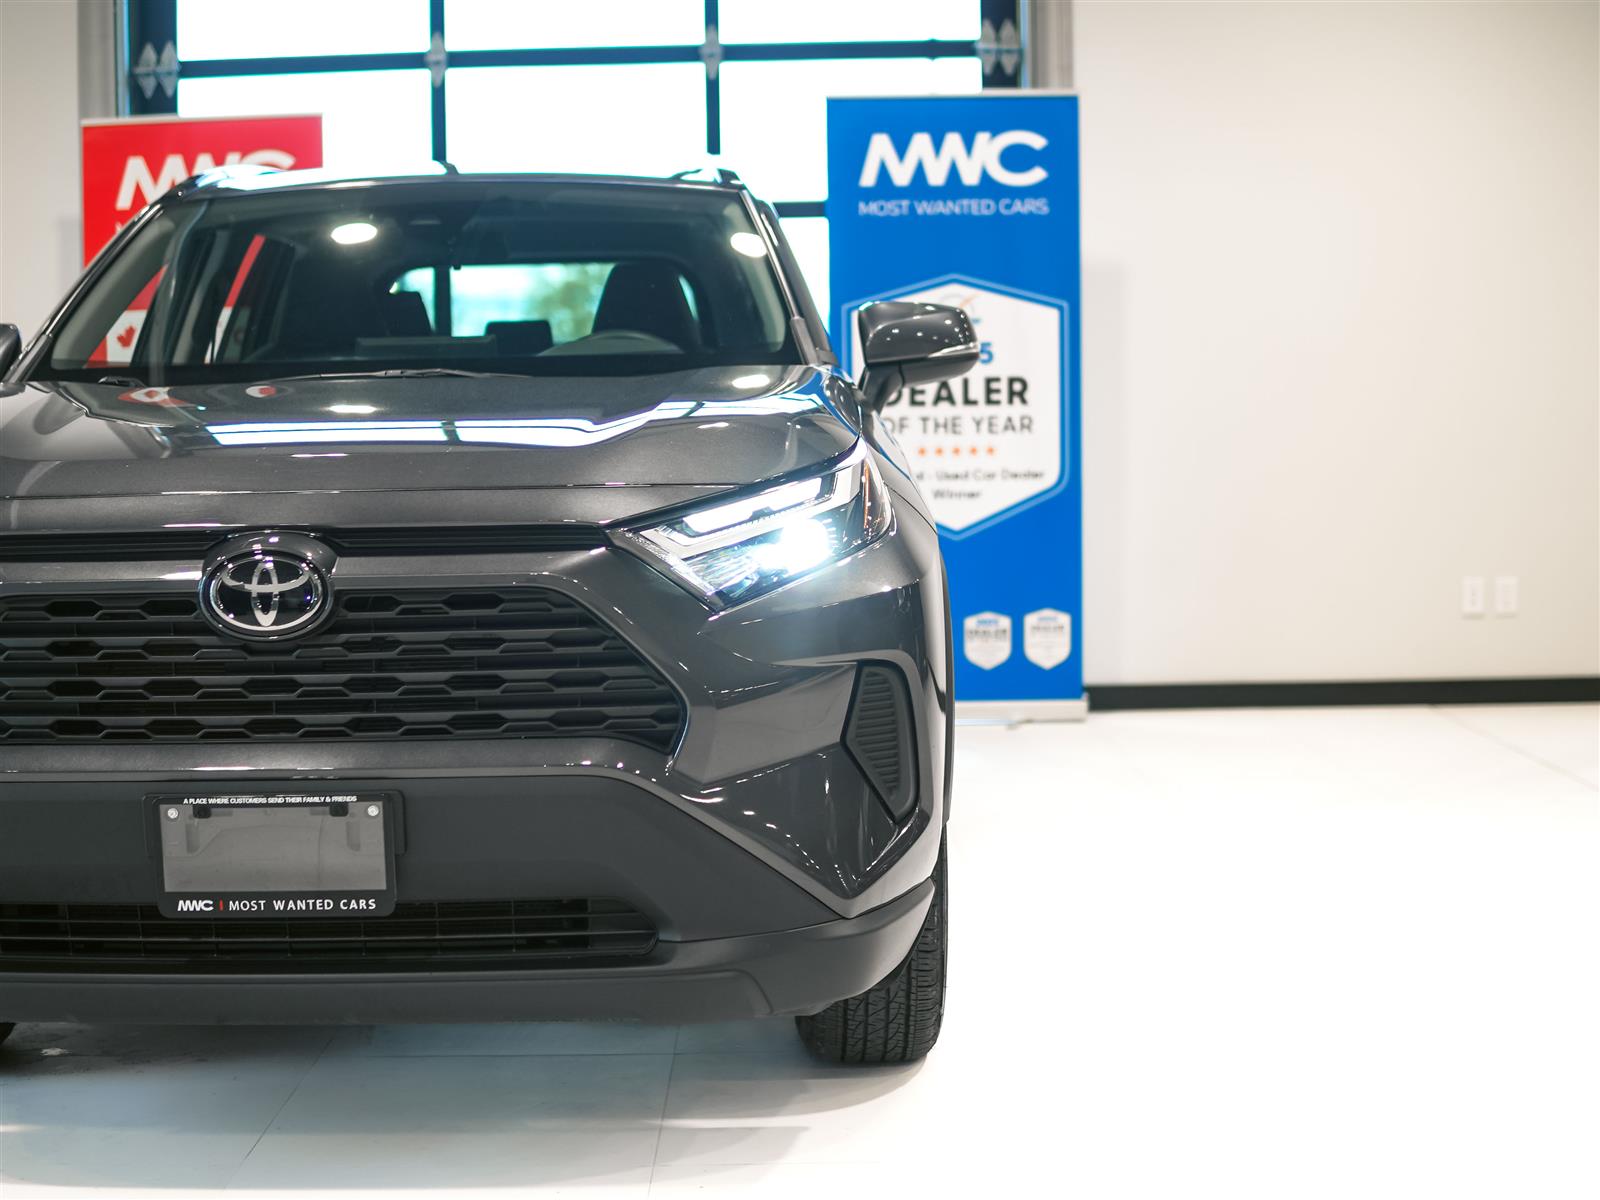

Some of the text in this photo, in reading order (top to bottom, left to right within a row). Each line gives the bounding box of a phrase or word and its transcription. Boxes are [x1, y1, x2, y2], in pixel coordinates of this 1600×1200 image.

[858, 129, 1048, 188] MWC
[858, 198, 1050, 216] MOST WANTED CARS
[919, 416, 962, 434] THE
[972, 415, 1034, 434] YEAR
[177, 898, 376, 911] MWC MOST WANTED CARS
